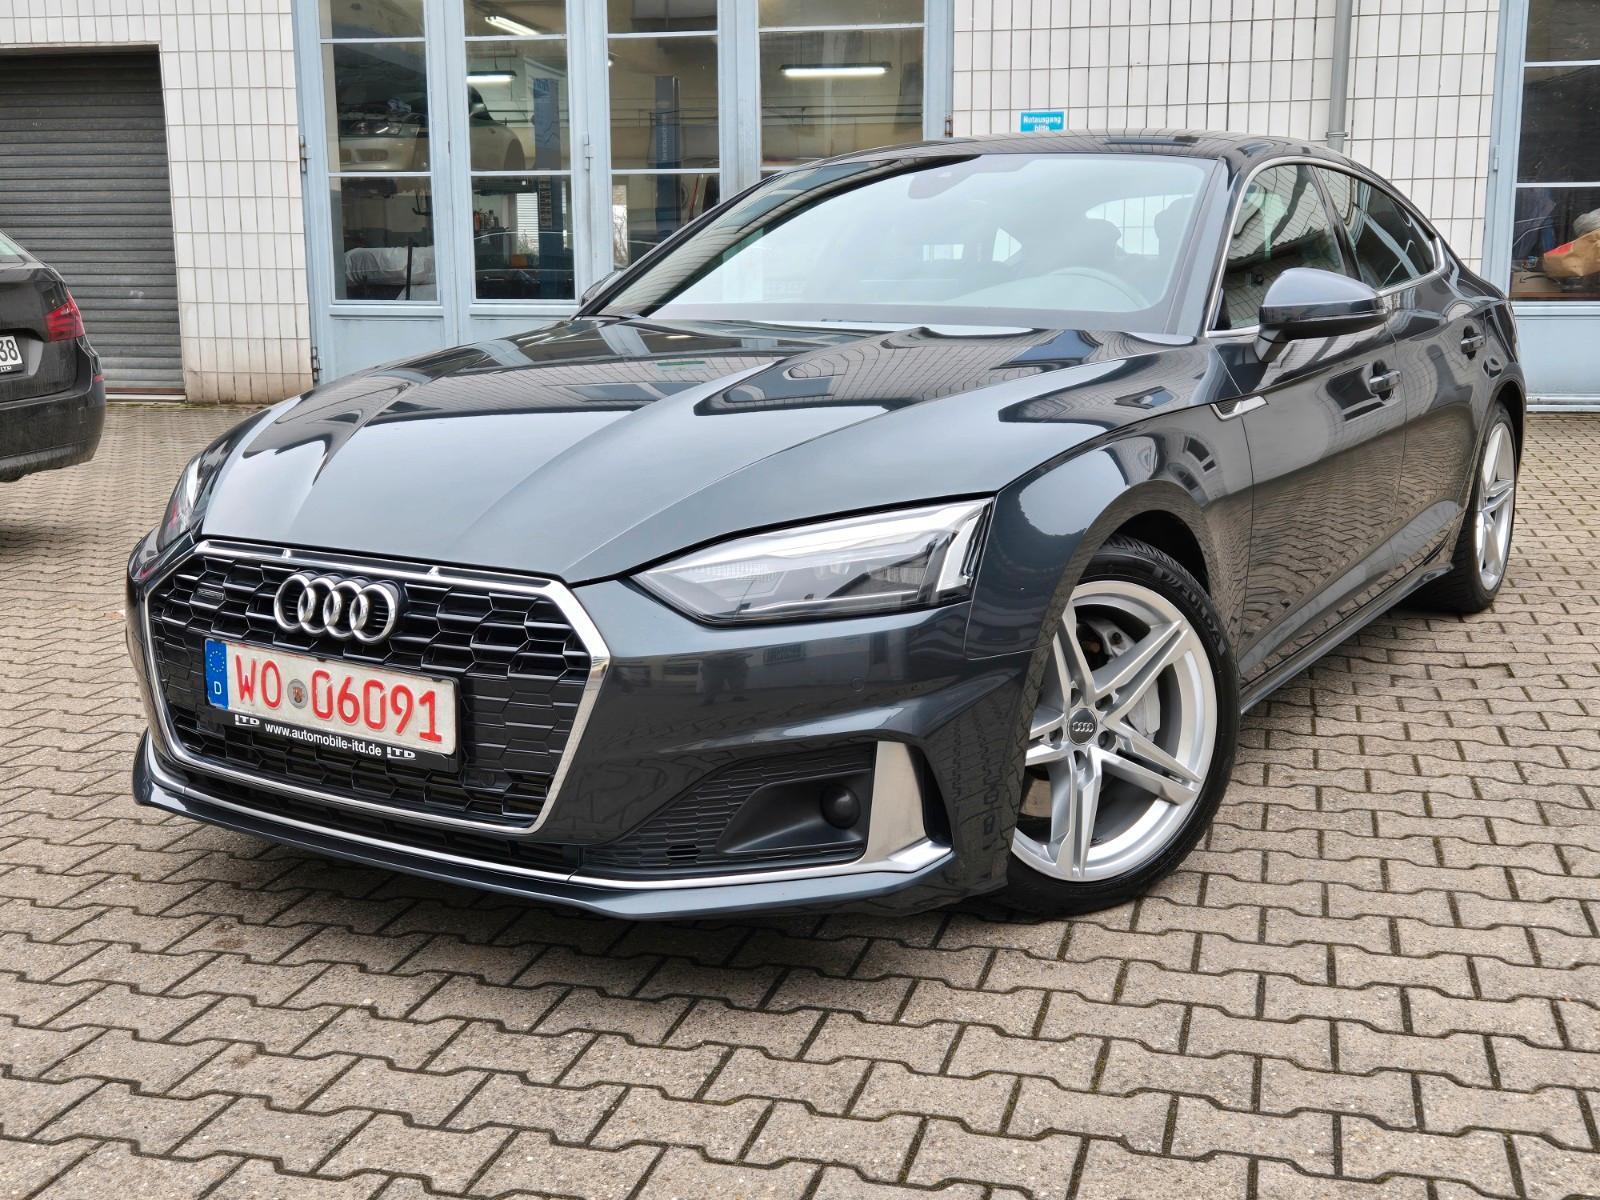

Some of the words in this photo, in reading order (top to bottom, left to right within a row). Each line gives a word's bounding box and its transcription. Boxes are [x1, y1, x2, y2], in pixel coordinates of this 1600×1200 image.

[213, 681, 222, 695] D
[235, 654, 282, 709] WO
[311, 669, 443, 744] 06091
[264, 722, 382, 757] www.automobile-itd.de
